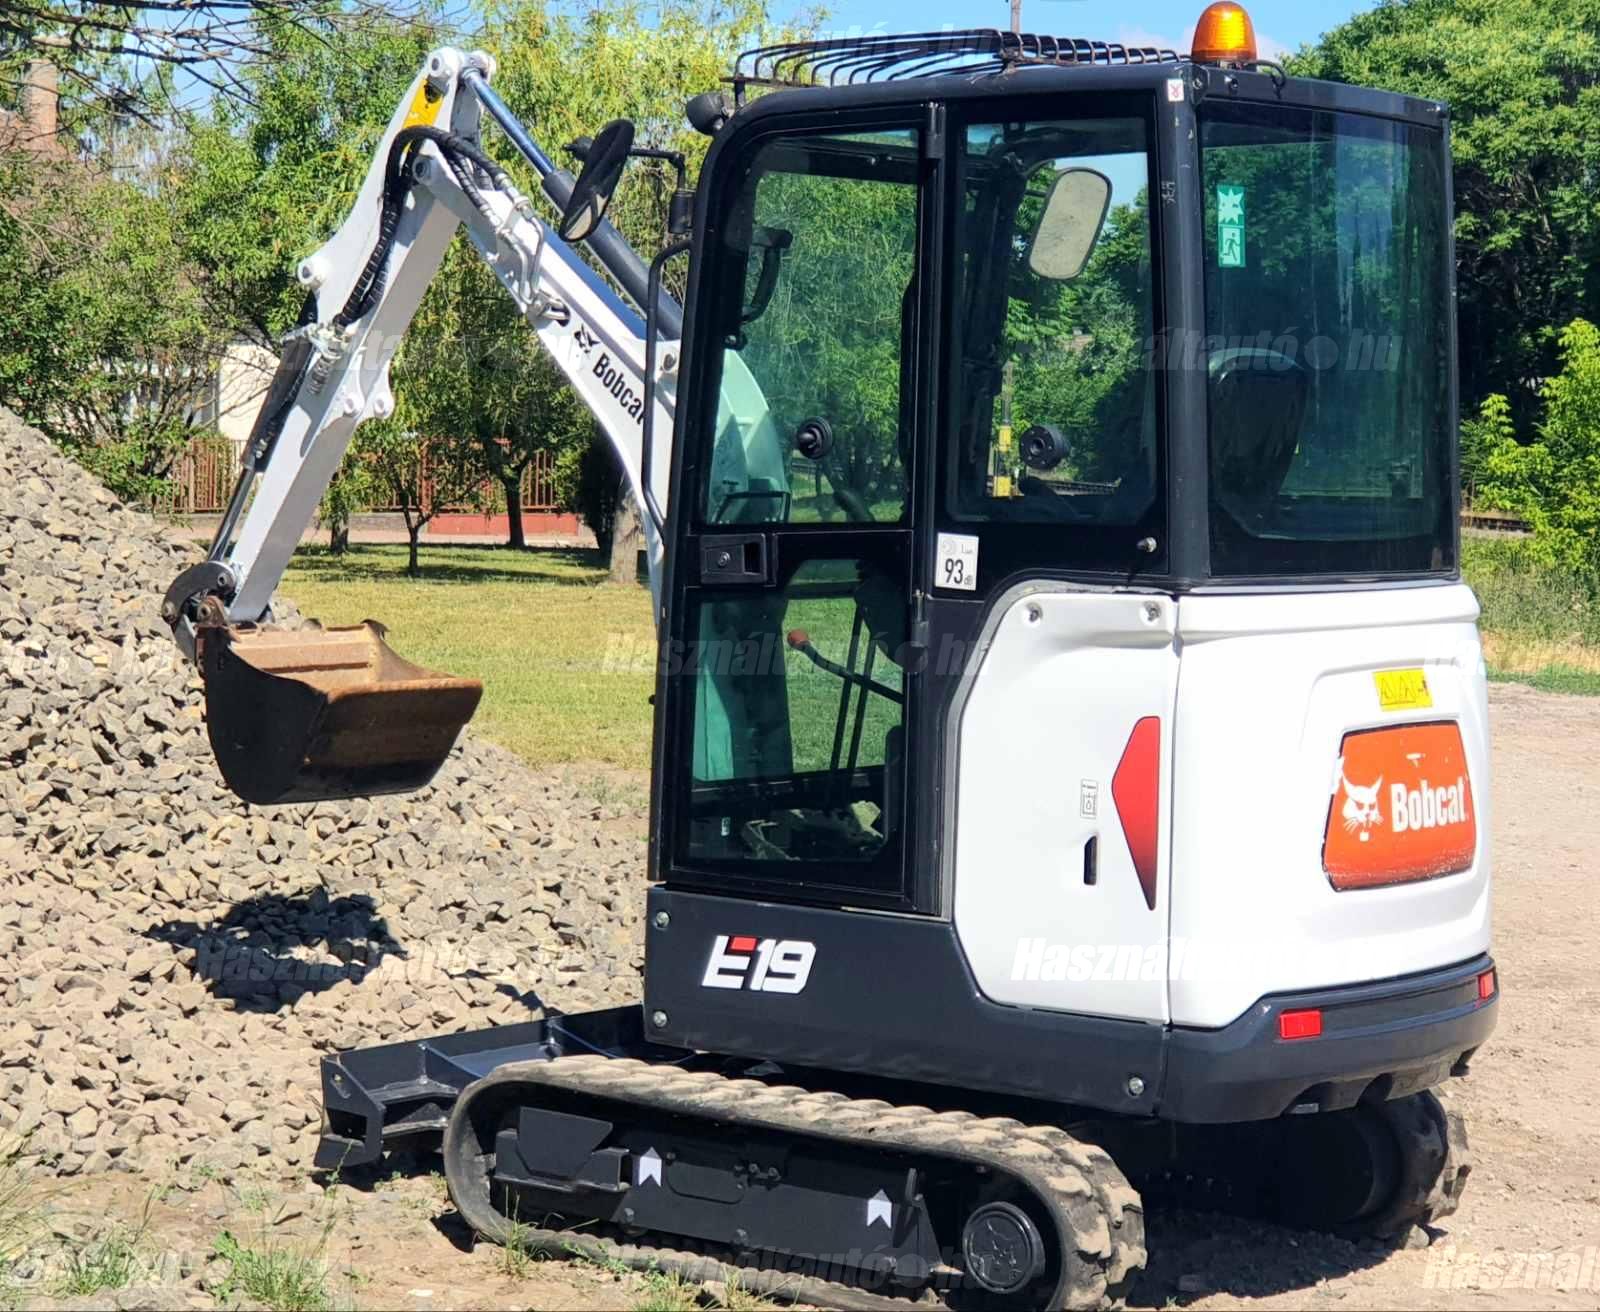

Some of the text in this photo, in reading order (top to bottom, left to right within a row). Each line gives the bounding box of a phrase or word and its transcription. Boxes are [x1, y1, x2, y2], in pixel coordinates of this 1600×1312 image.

[945, 558, 964, 585] 93
[1390, 776, 1466, 833] Bobcat
[701, 935, 817, 994] E19
